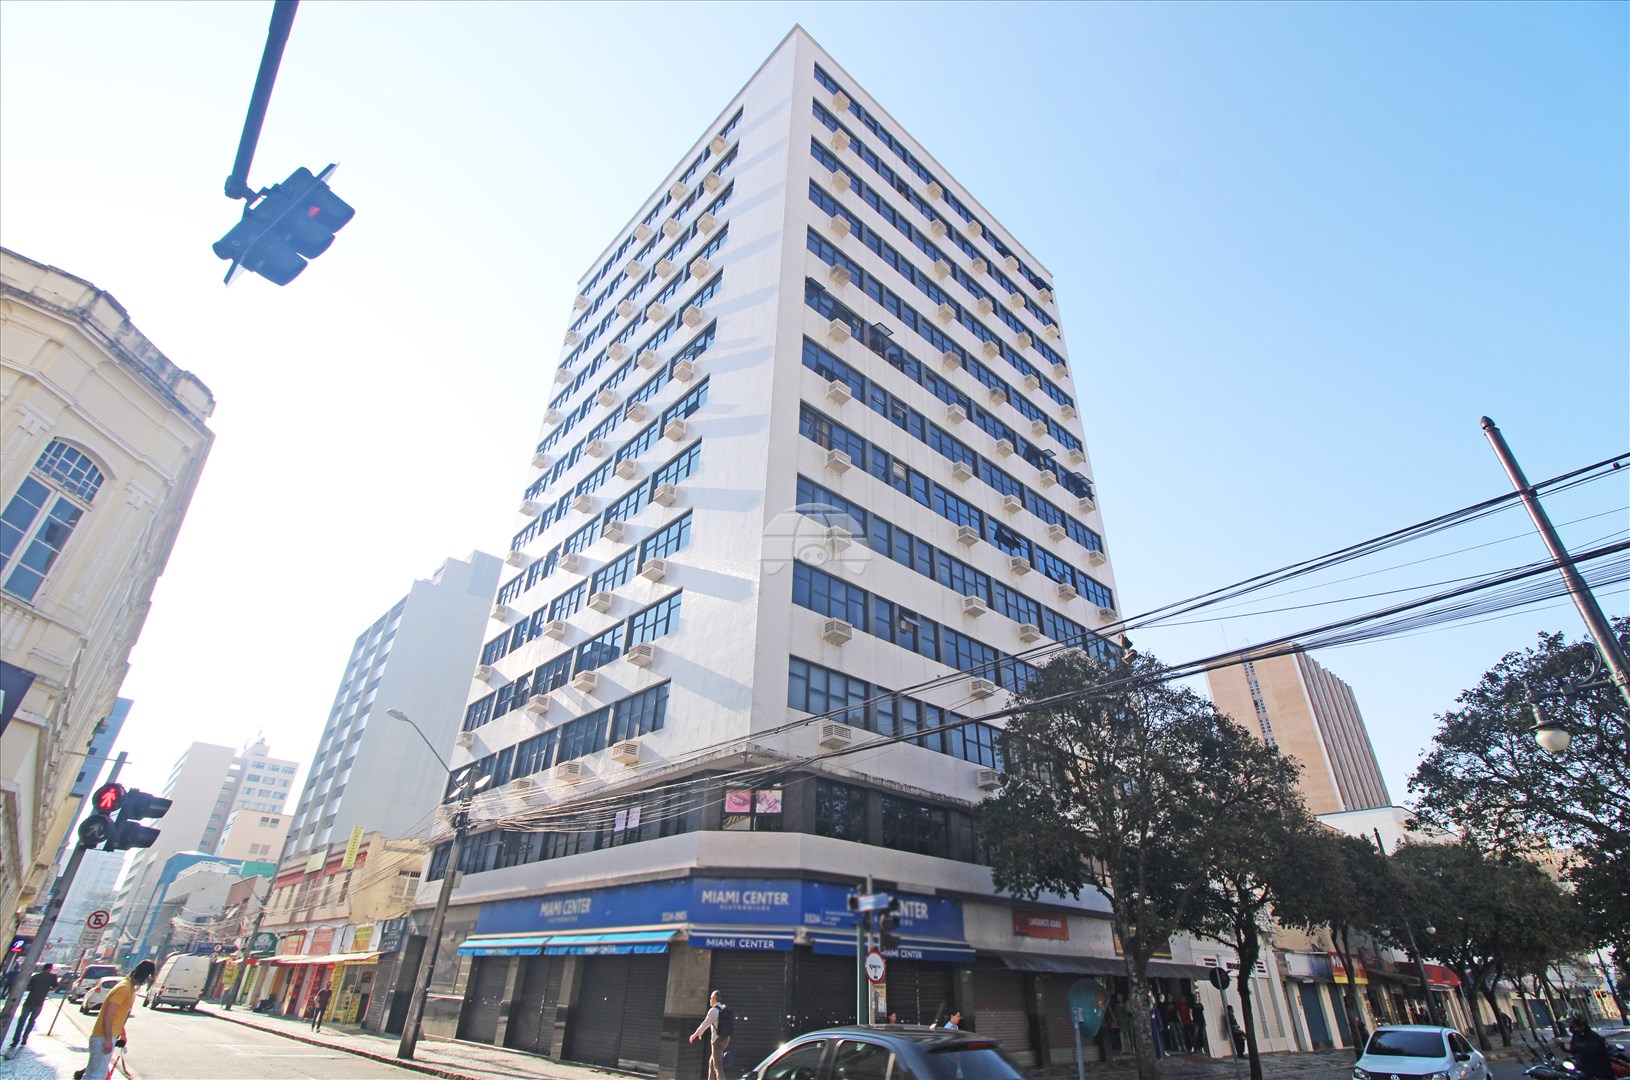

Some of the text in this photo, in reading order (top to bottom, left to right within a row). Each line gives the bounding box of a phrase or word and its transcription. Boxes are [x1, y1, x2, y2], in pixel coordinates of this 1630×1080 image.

[702, 890, 789, 906] MIAMI CENTER
[540, 898, 591, 916] MIAMI CENTER
[706, 938, 775, 949] MIAMI CENTER
[900, 949, 923, 959] CENTER
